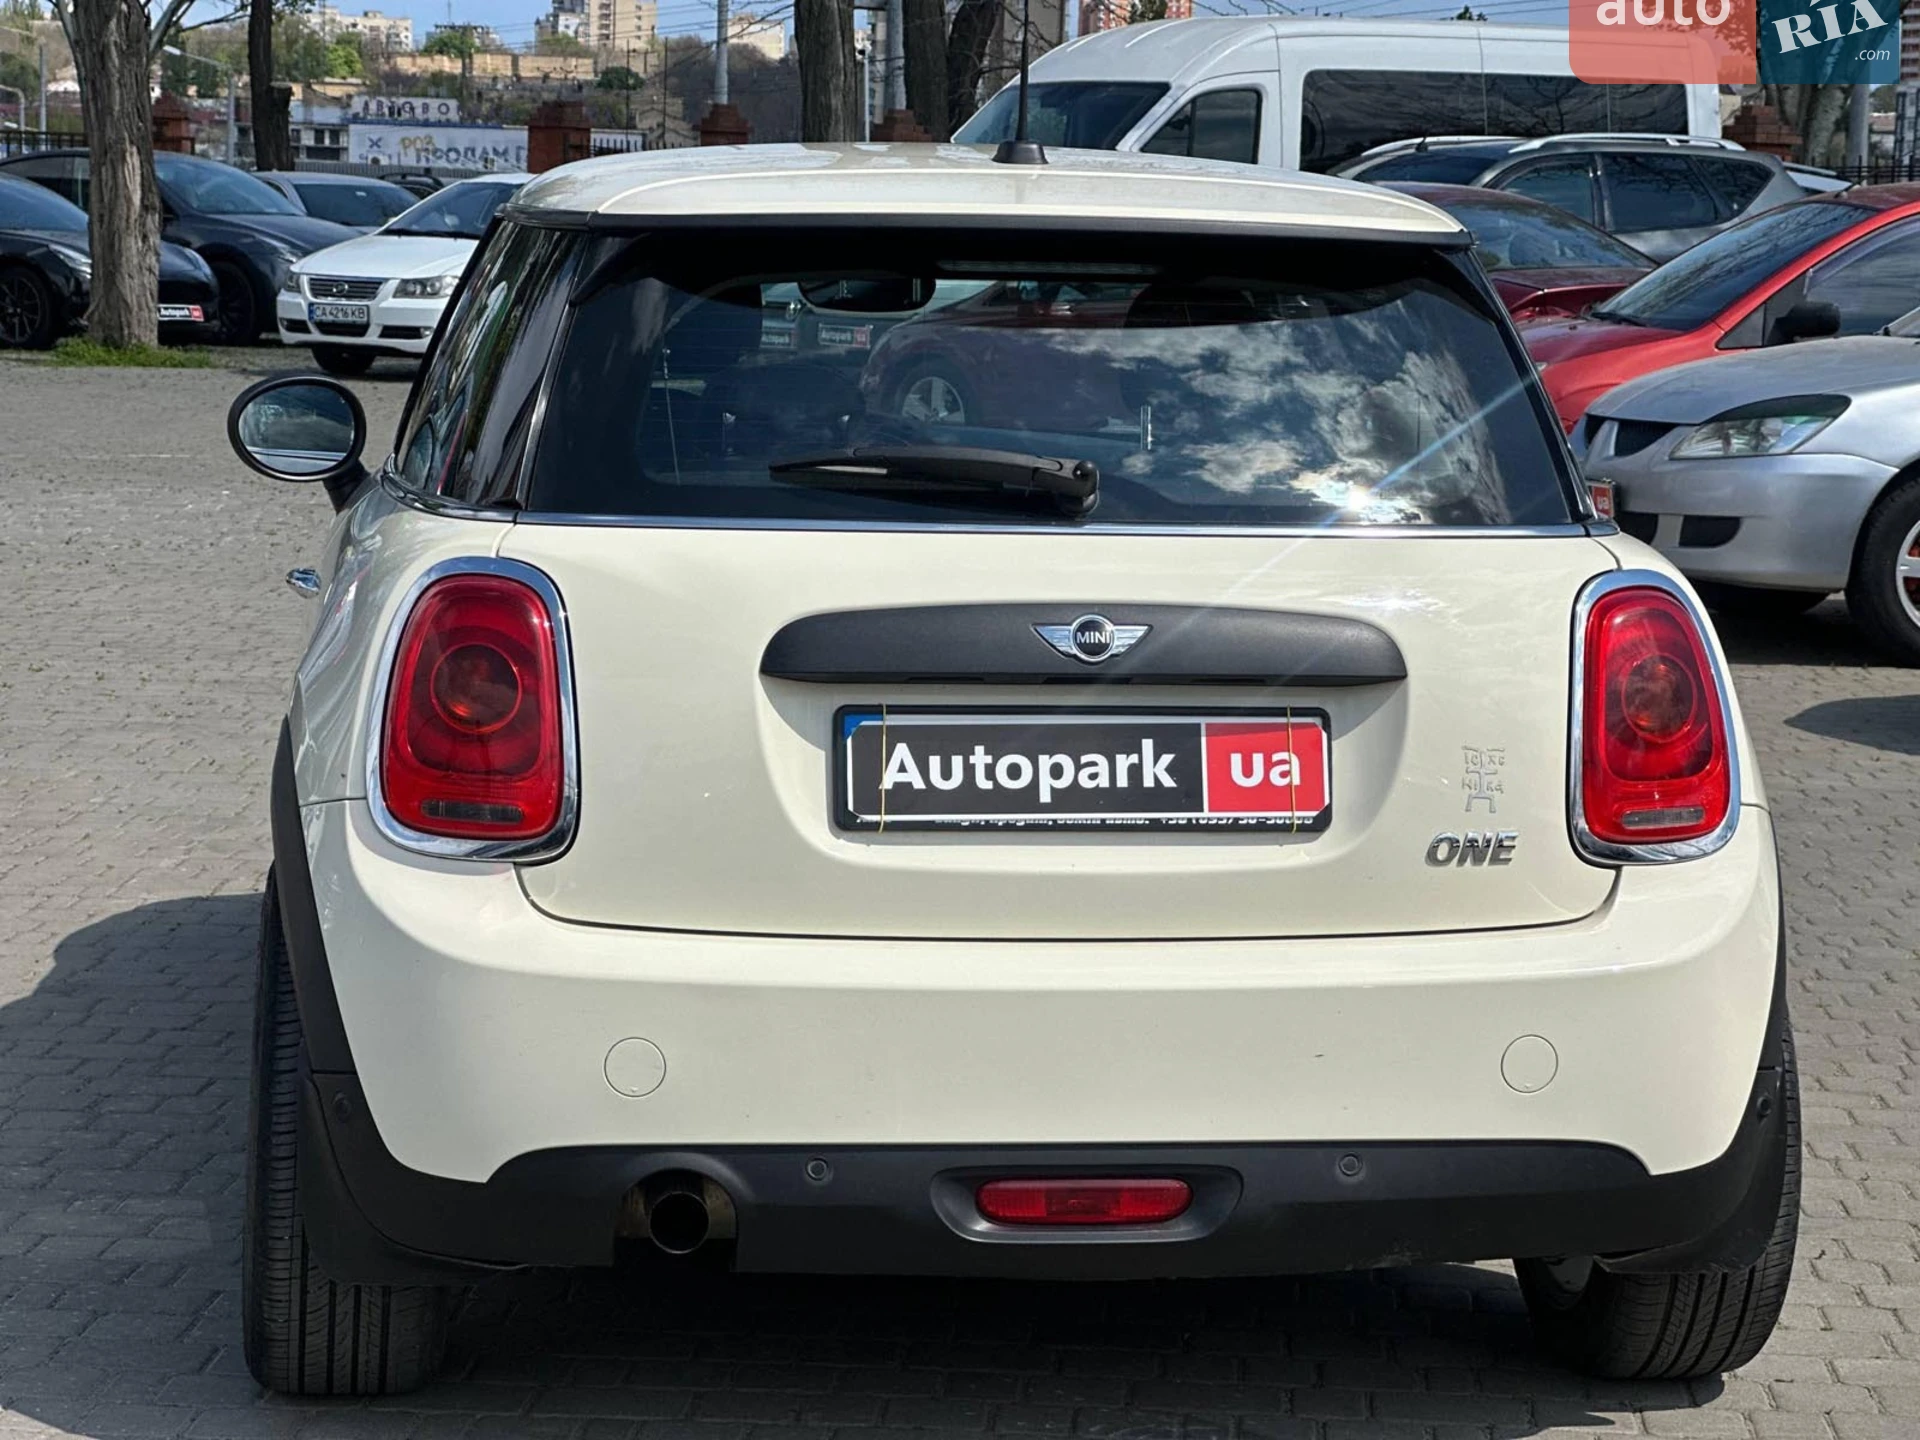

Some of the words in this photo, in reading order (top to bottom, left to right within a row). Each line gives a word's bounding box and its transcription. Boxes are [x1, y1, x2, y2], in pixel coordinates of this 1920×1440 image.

[1076, 631, 1112, 644] MINI
[879, 738, 1178, 803] Autopark
[1229, 750, 1301, 788] ua
[1424, 831, 1519, 867] ONE
